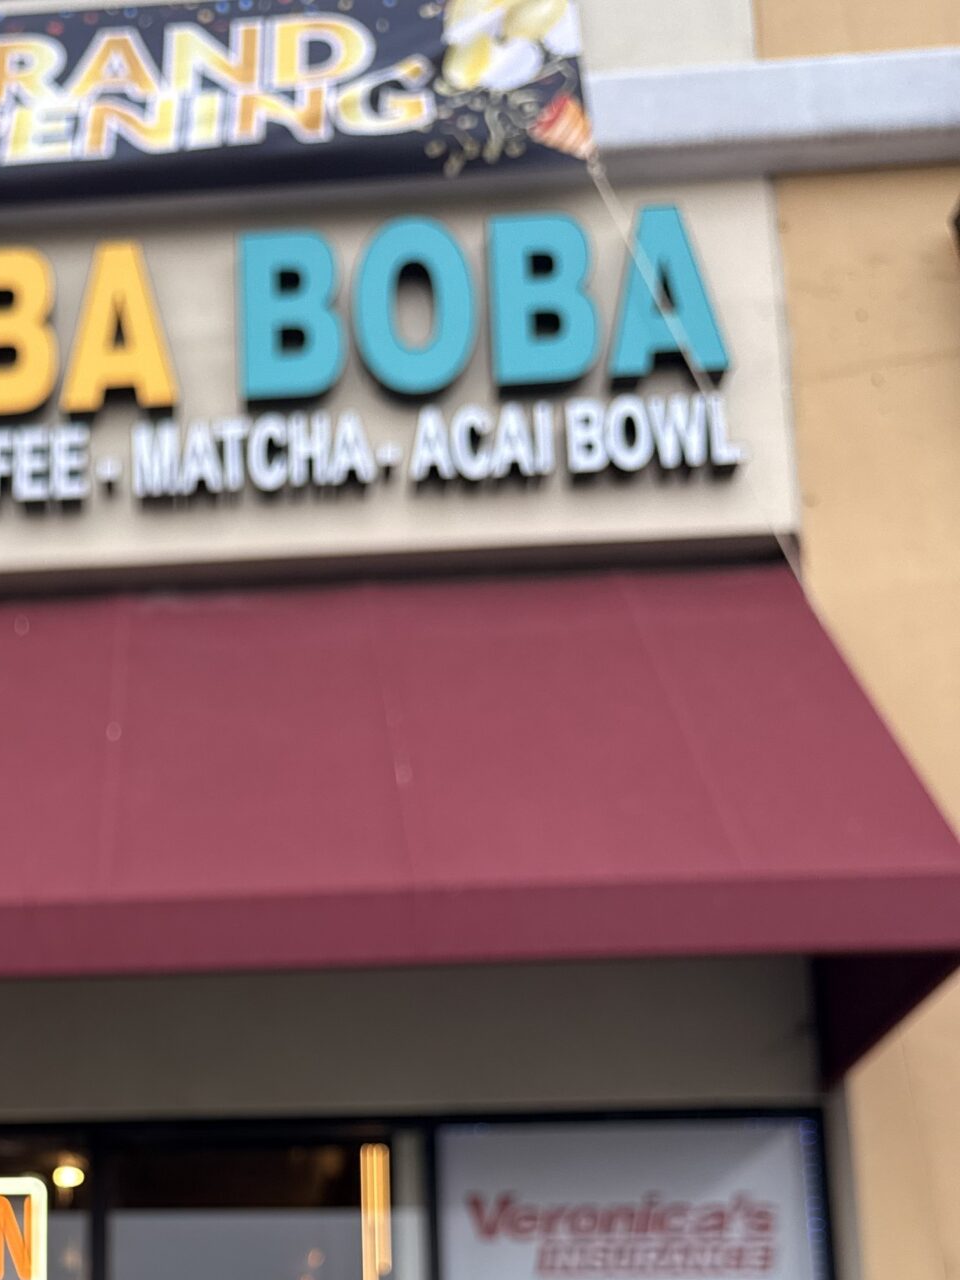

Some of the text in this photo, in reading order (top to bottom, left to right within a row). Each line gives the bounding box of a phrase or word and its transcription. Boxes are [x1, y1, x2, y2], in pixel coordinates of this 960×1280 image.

[237, 203, 731, 400] BOBA
[131, 406, 378, 499] MATCHA
[410, 402, 555, 481] ACAI
[565, 392, 744, 474] BOWL
[466, 1192, 776, 1243] Veronica's
